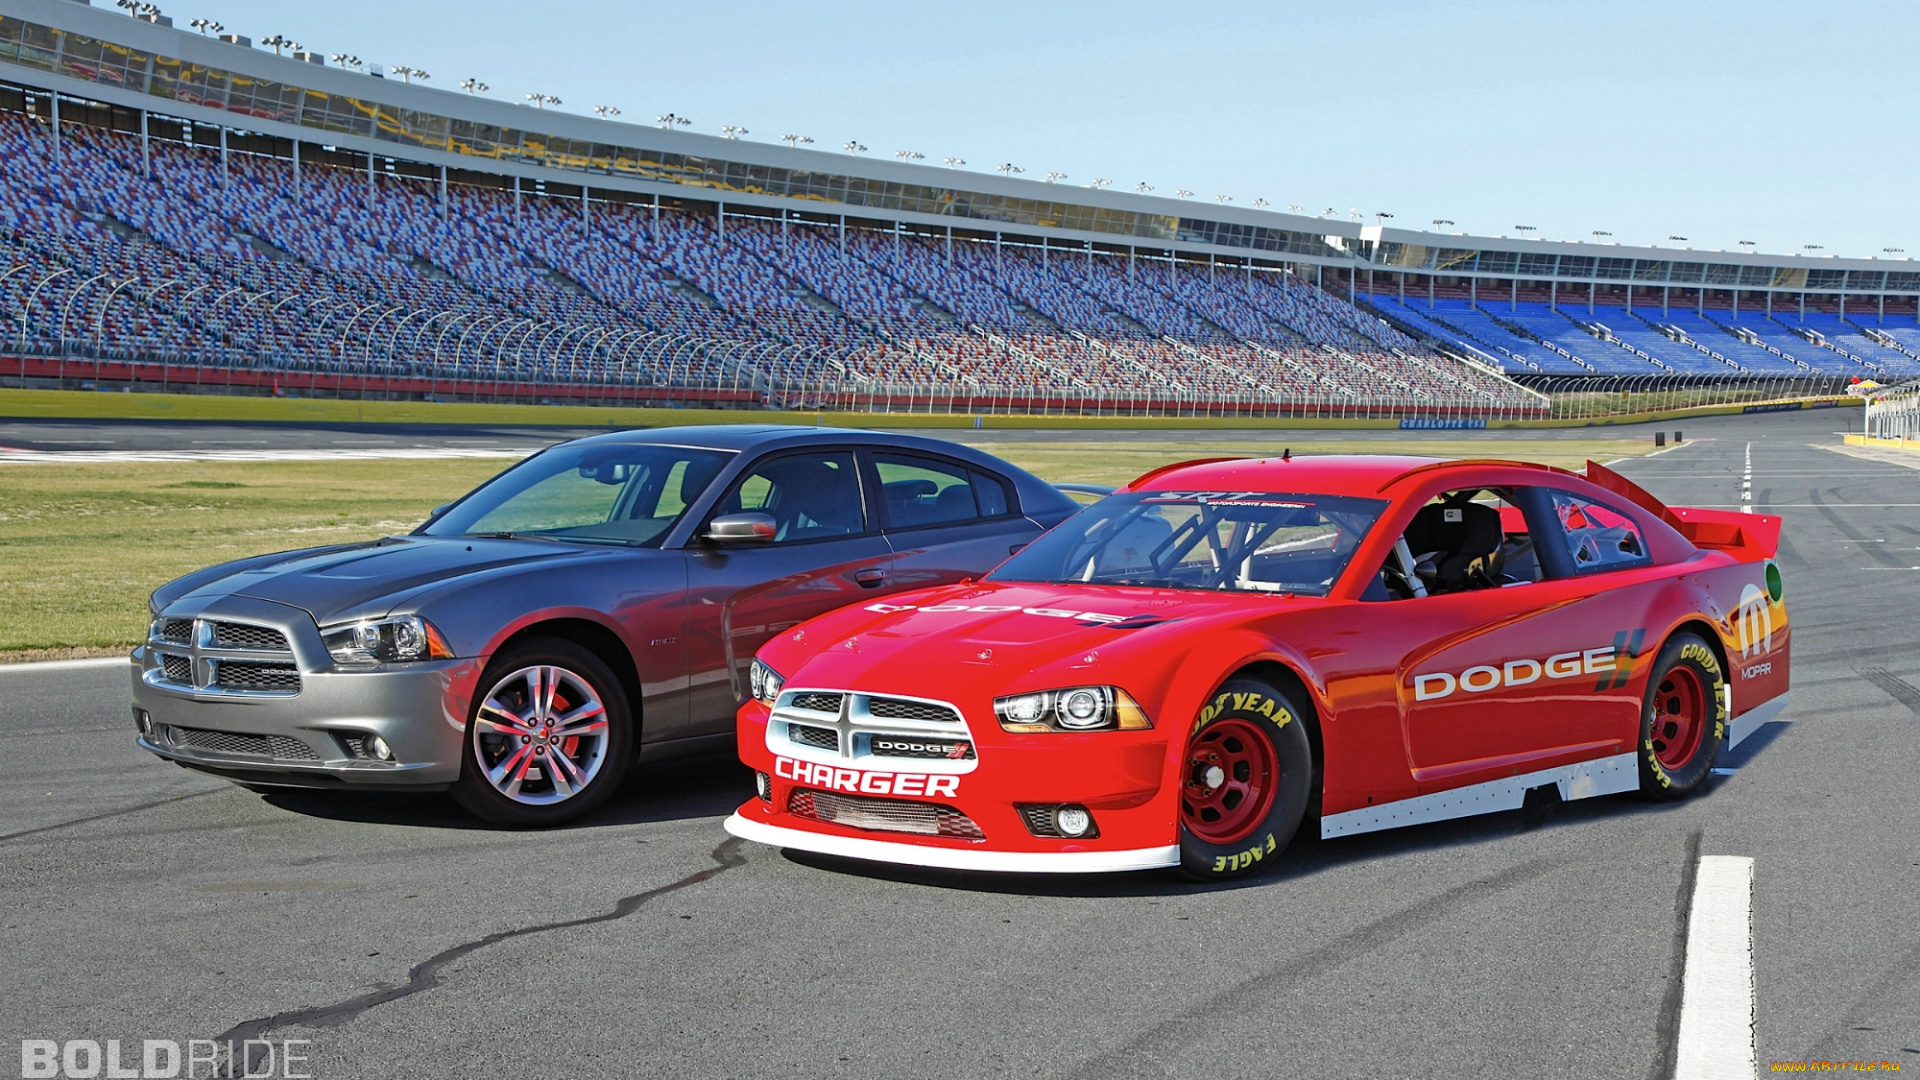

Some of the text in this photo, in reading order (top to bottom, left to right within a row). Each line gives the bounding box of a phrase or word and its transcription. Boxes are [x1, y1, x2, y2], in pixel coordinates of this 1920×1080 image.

[1401, 420, 1486, 429] CHARLOTTE USA
[1146, 492, 1267, 503] SRT
[864, 603, 1128, 624] DODGE
[1414, 646, 1617, 701] DODGE
[1741, 662, 1772, 680] MOPAR
[1680, 643, 1726, 740] GOODYEAR
[878, 741, 957, 753] DODGE
[775, 756, 961, 798] CHARGER
[1212, 833, 1276, 872] EAGLE
